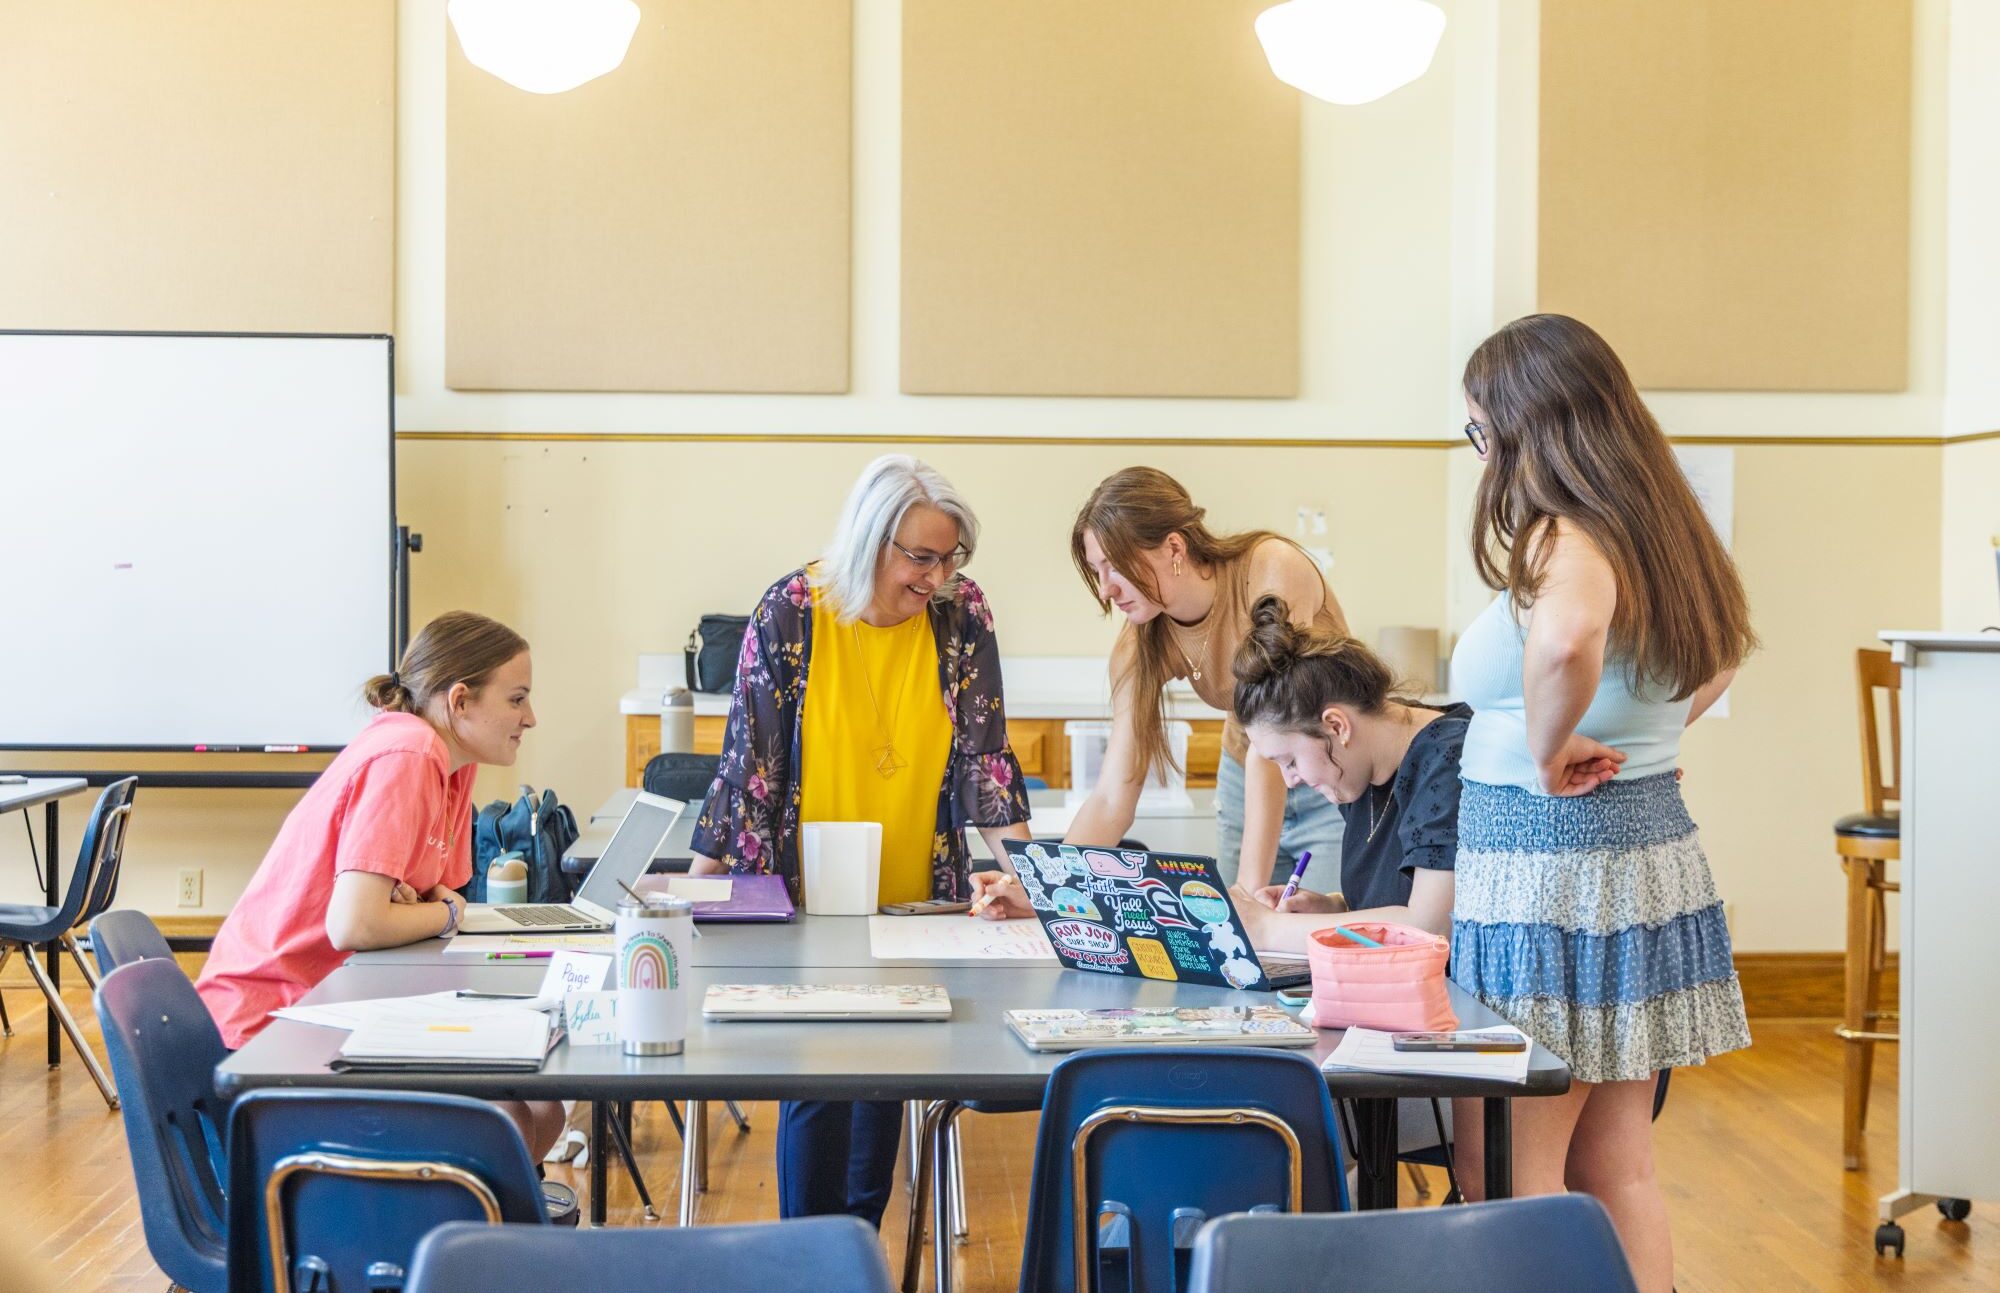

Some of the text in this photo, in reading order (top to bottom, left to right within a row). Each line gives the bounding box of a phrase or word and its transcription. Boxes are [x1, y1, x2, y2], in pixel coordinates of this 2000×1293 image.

[1079, 875, 1117, 898] faith
[1104, 895, 1143, 914] Y'all
[1115, 912, 1155, 930] Jesus
[1123, 909, 1150, 920] need
[1055, 924, 1113, 942] RON JON
[1066, 938, 1109, 949] SURF SHOP
[1083, 953, 1098, 964] OF
[562, 962, 590, 990] Paige
[570, 999, 600, 1031] Lydia
